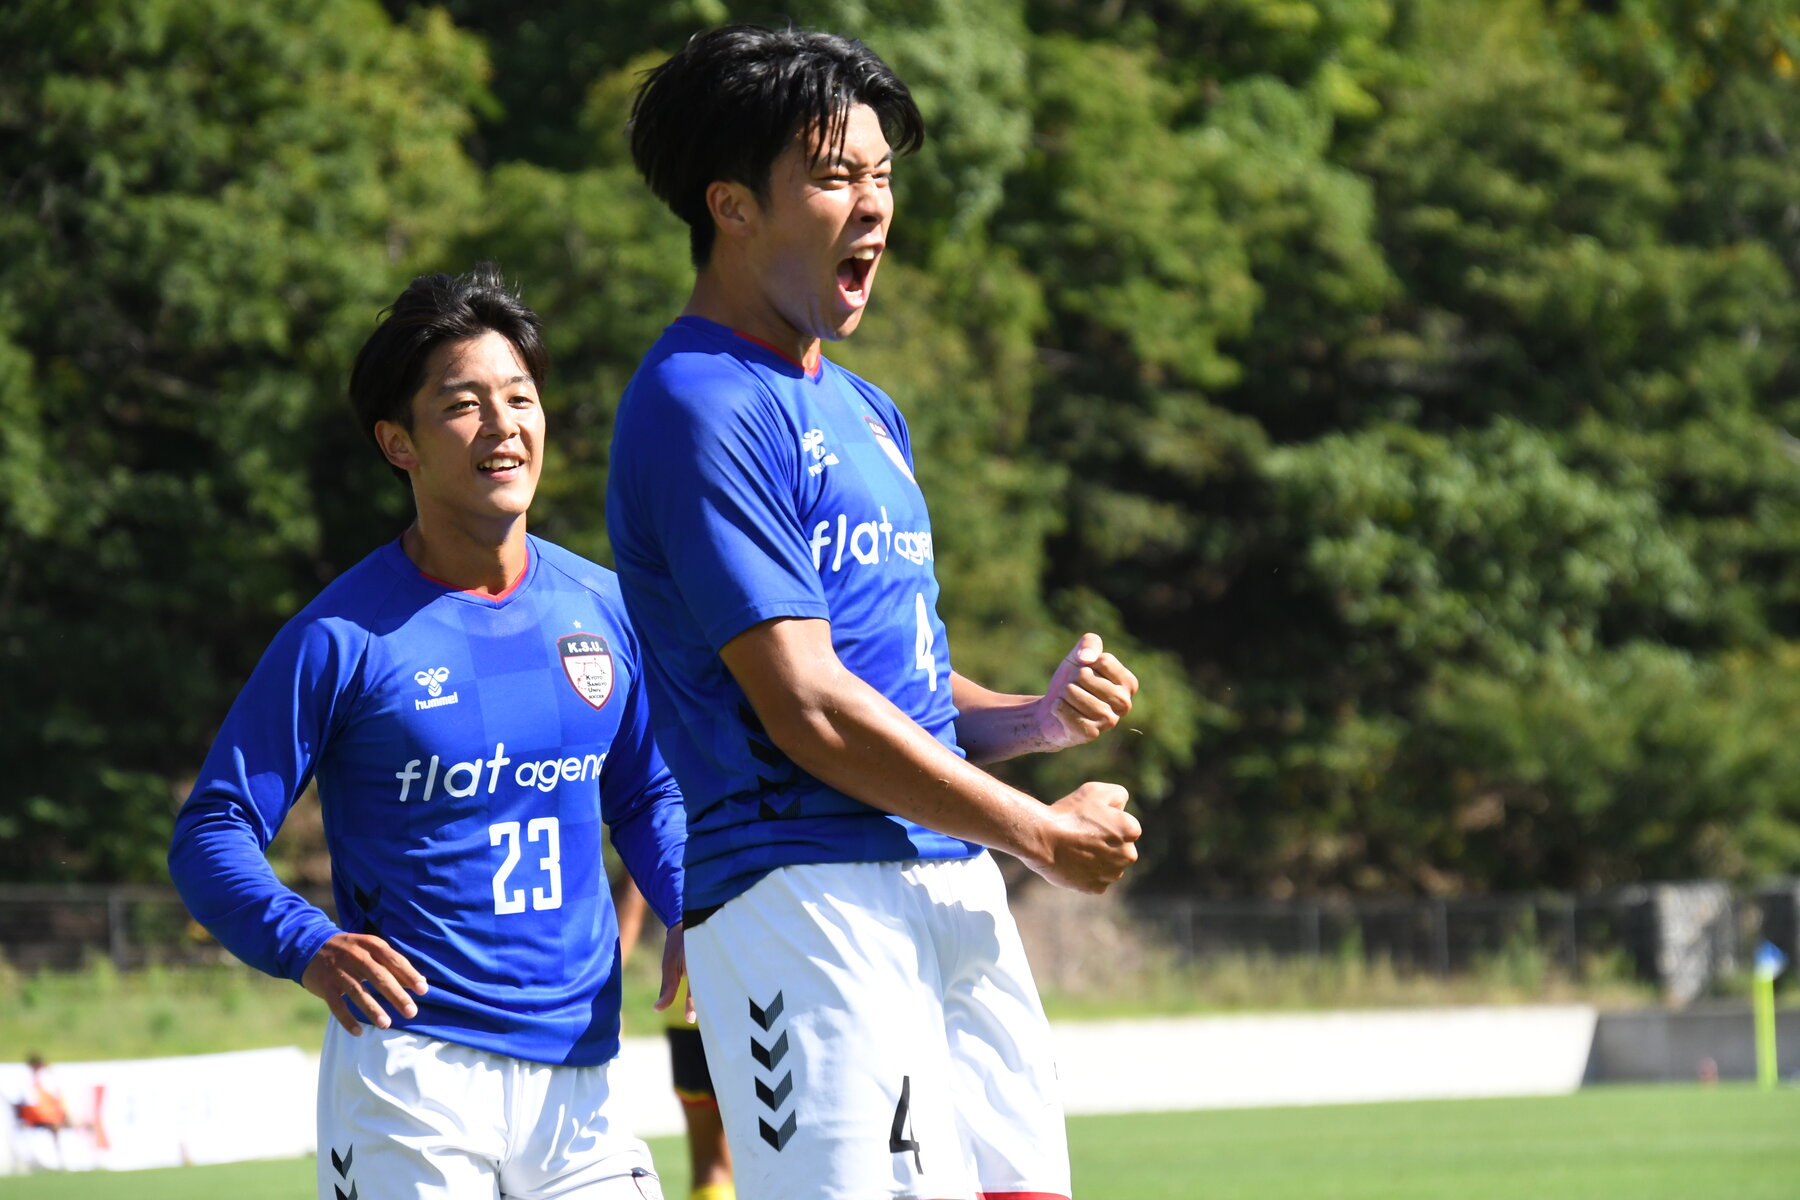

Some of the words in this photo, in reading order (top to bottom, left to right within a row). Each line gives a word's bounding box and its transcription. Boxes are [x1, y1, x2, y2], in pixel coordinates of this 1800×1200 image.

[808, 505, 893, 572] flat
[567, 641, 604, 653] K.S.U.
[915, 592, 937, 691] 4
[414, 691, 459, 711] hummel
[394, 742, 511, 802] flat
[488, 816, 563, 916] 23
[888, 1074, 924, 1175] 4
